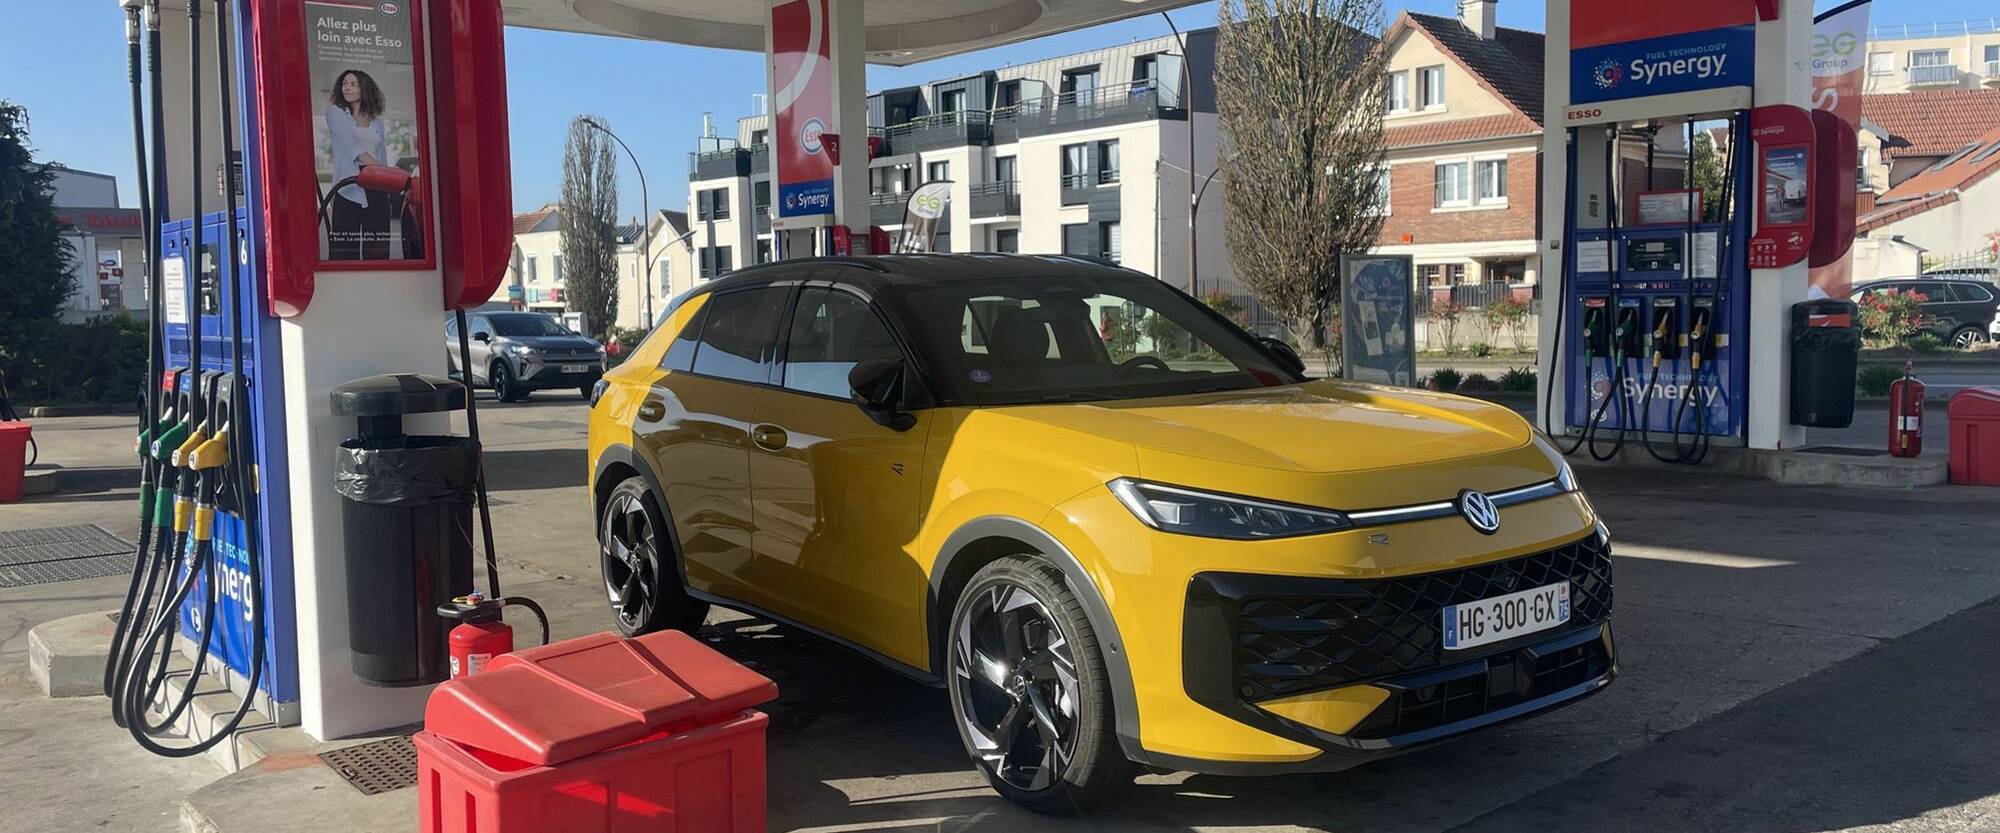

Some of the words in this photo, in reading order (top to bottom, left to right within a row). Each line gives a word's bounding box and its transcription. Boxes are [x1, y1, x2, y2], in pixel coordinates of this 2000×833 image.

[317, 17, 349, 30] Allez
[352, 20, 377, 33] plus
[317, 30, 340, 42] loin
[344, 36, 373, 45] avec
[375, 35, 402, 47] Esso
[1646, 52, 1667, 60] FUEL
[1668, 43, 1726, 57] TECHNOLOGY
[1630, 53, 1727, 85] Synergy
[1812, 59, 1848, 69] Group
[1567, 108, 1602, 120] ESSO
[805, 130, 820, 142] Ess
[831, 141, 837, 152] 2
[798, 193, 829, 209] Synergy
[240, 240, 248, 265] 6
[1560, 601, 1569, 618] 75
